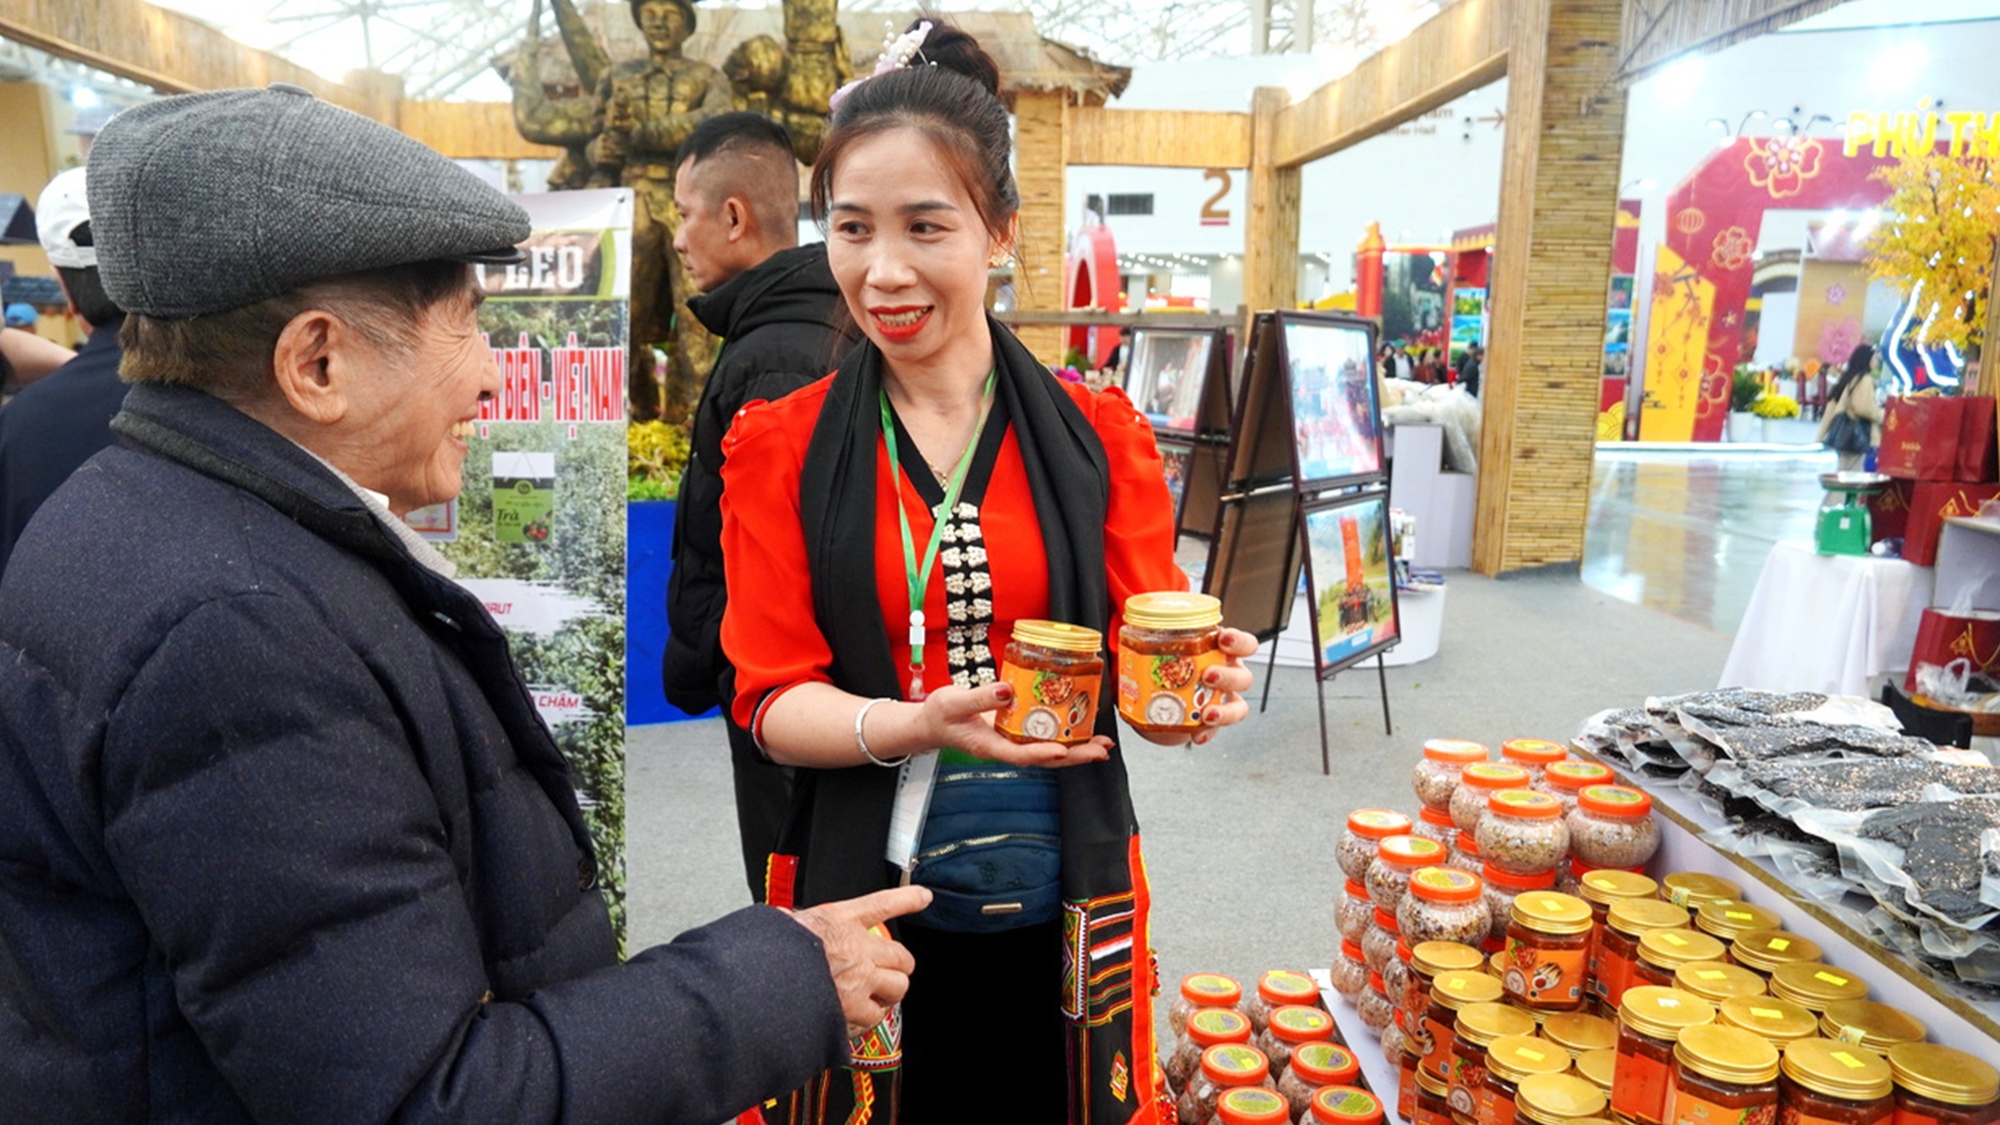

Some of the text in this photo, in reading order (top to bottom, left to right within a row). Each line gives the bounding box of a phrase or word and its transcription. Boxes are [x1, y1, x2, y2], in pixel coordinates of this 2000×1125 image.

[1843, 96, 1938, 158] PHÚ
[1201, 169, 1232, 219] 2
[503, 246, 585, 290] LEO
[503, 332, 541, 422] BIÊN
[552, 332, 586, 439] VIỆT
[588, 348, 624, 422] NAM
[538, 692, 579, 711] CHẬM
